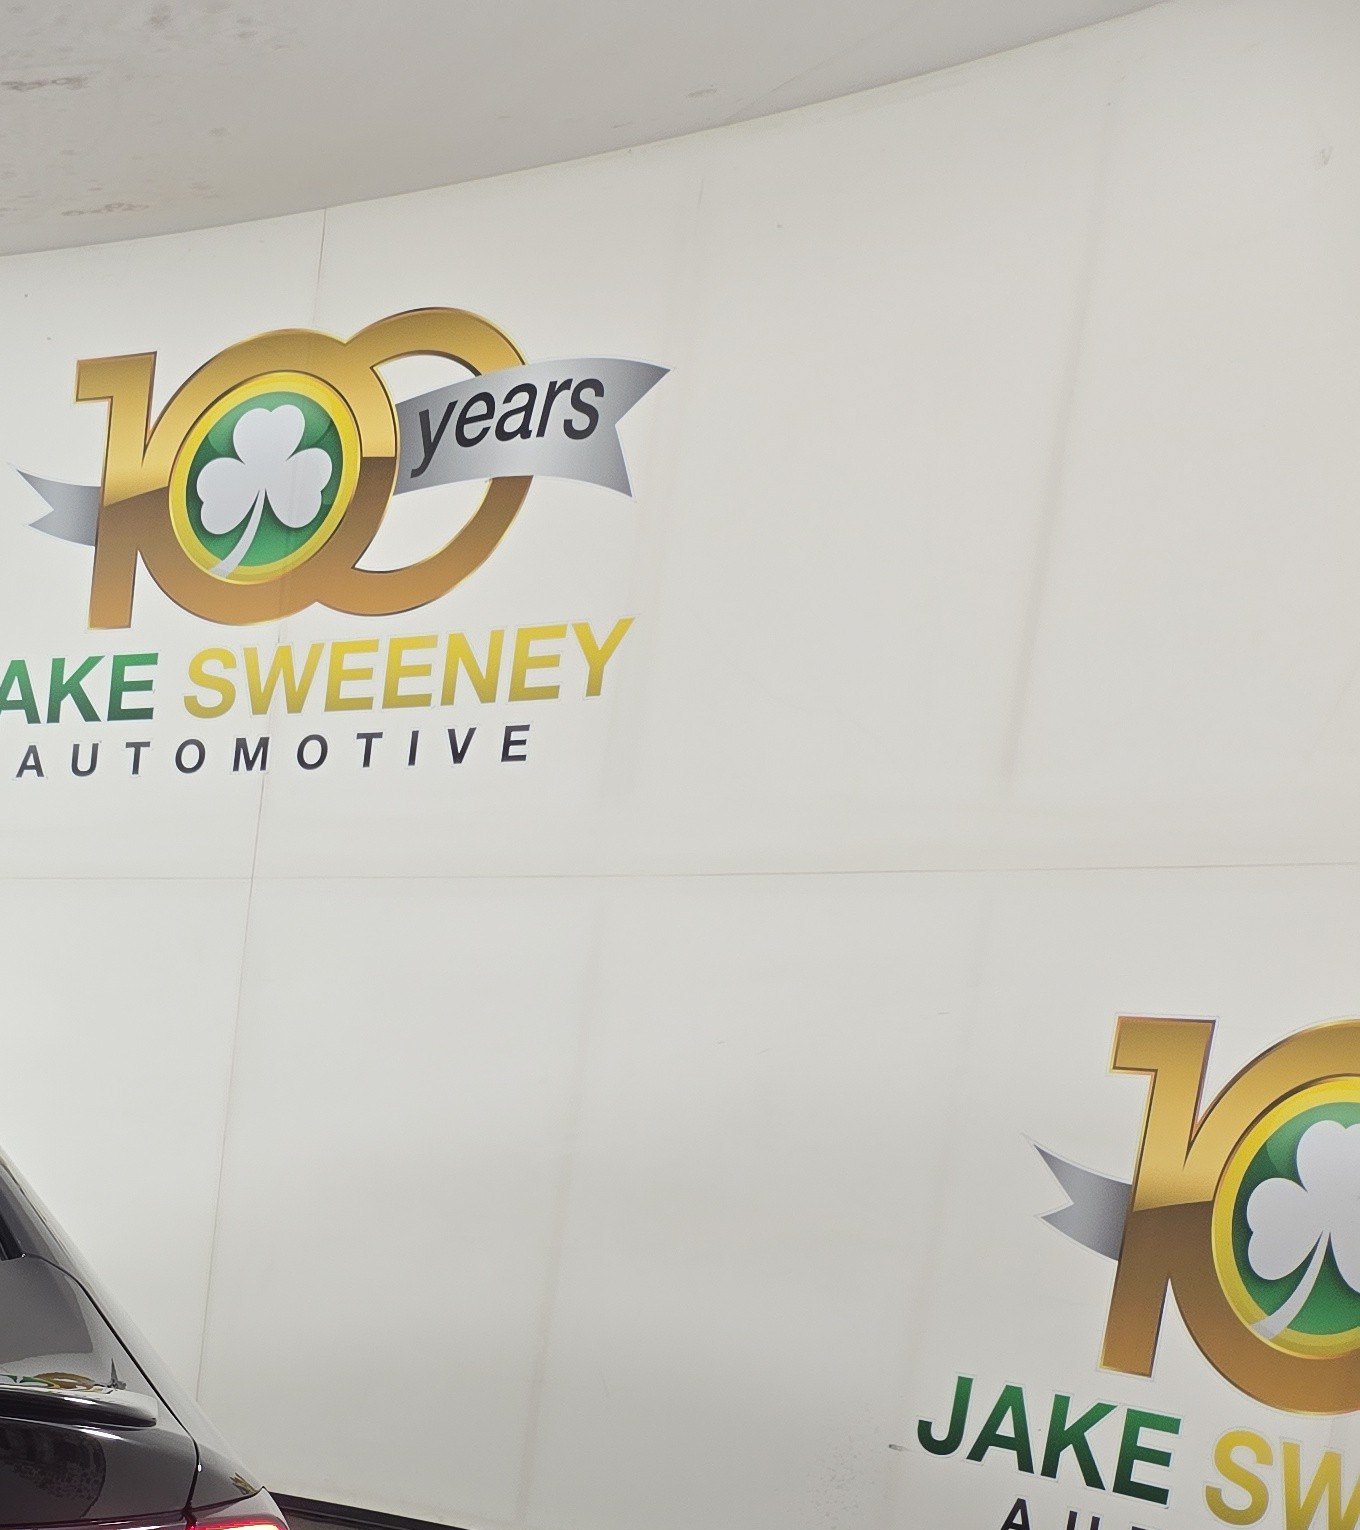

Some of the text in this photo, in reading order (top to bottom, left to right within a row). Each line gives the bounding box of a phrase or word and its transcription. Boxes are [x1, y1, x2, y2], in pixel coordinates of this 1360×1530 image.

[410, 375, 604, 478] years
[183, 617, 635, 719] SWEENEY
[15, 724, 532, 779] AUTOMOTIVE
[917, 1375, 1181, 1506] JAKE
